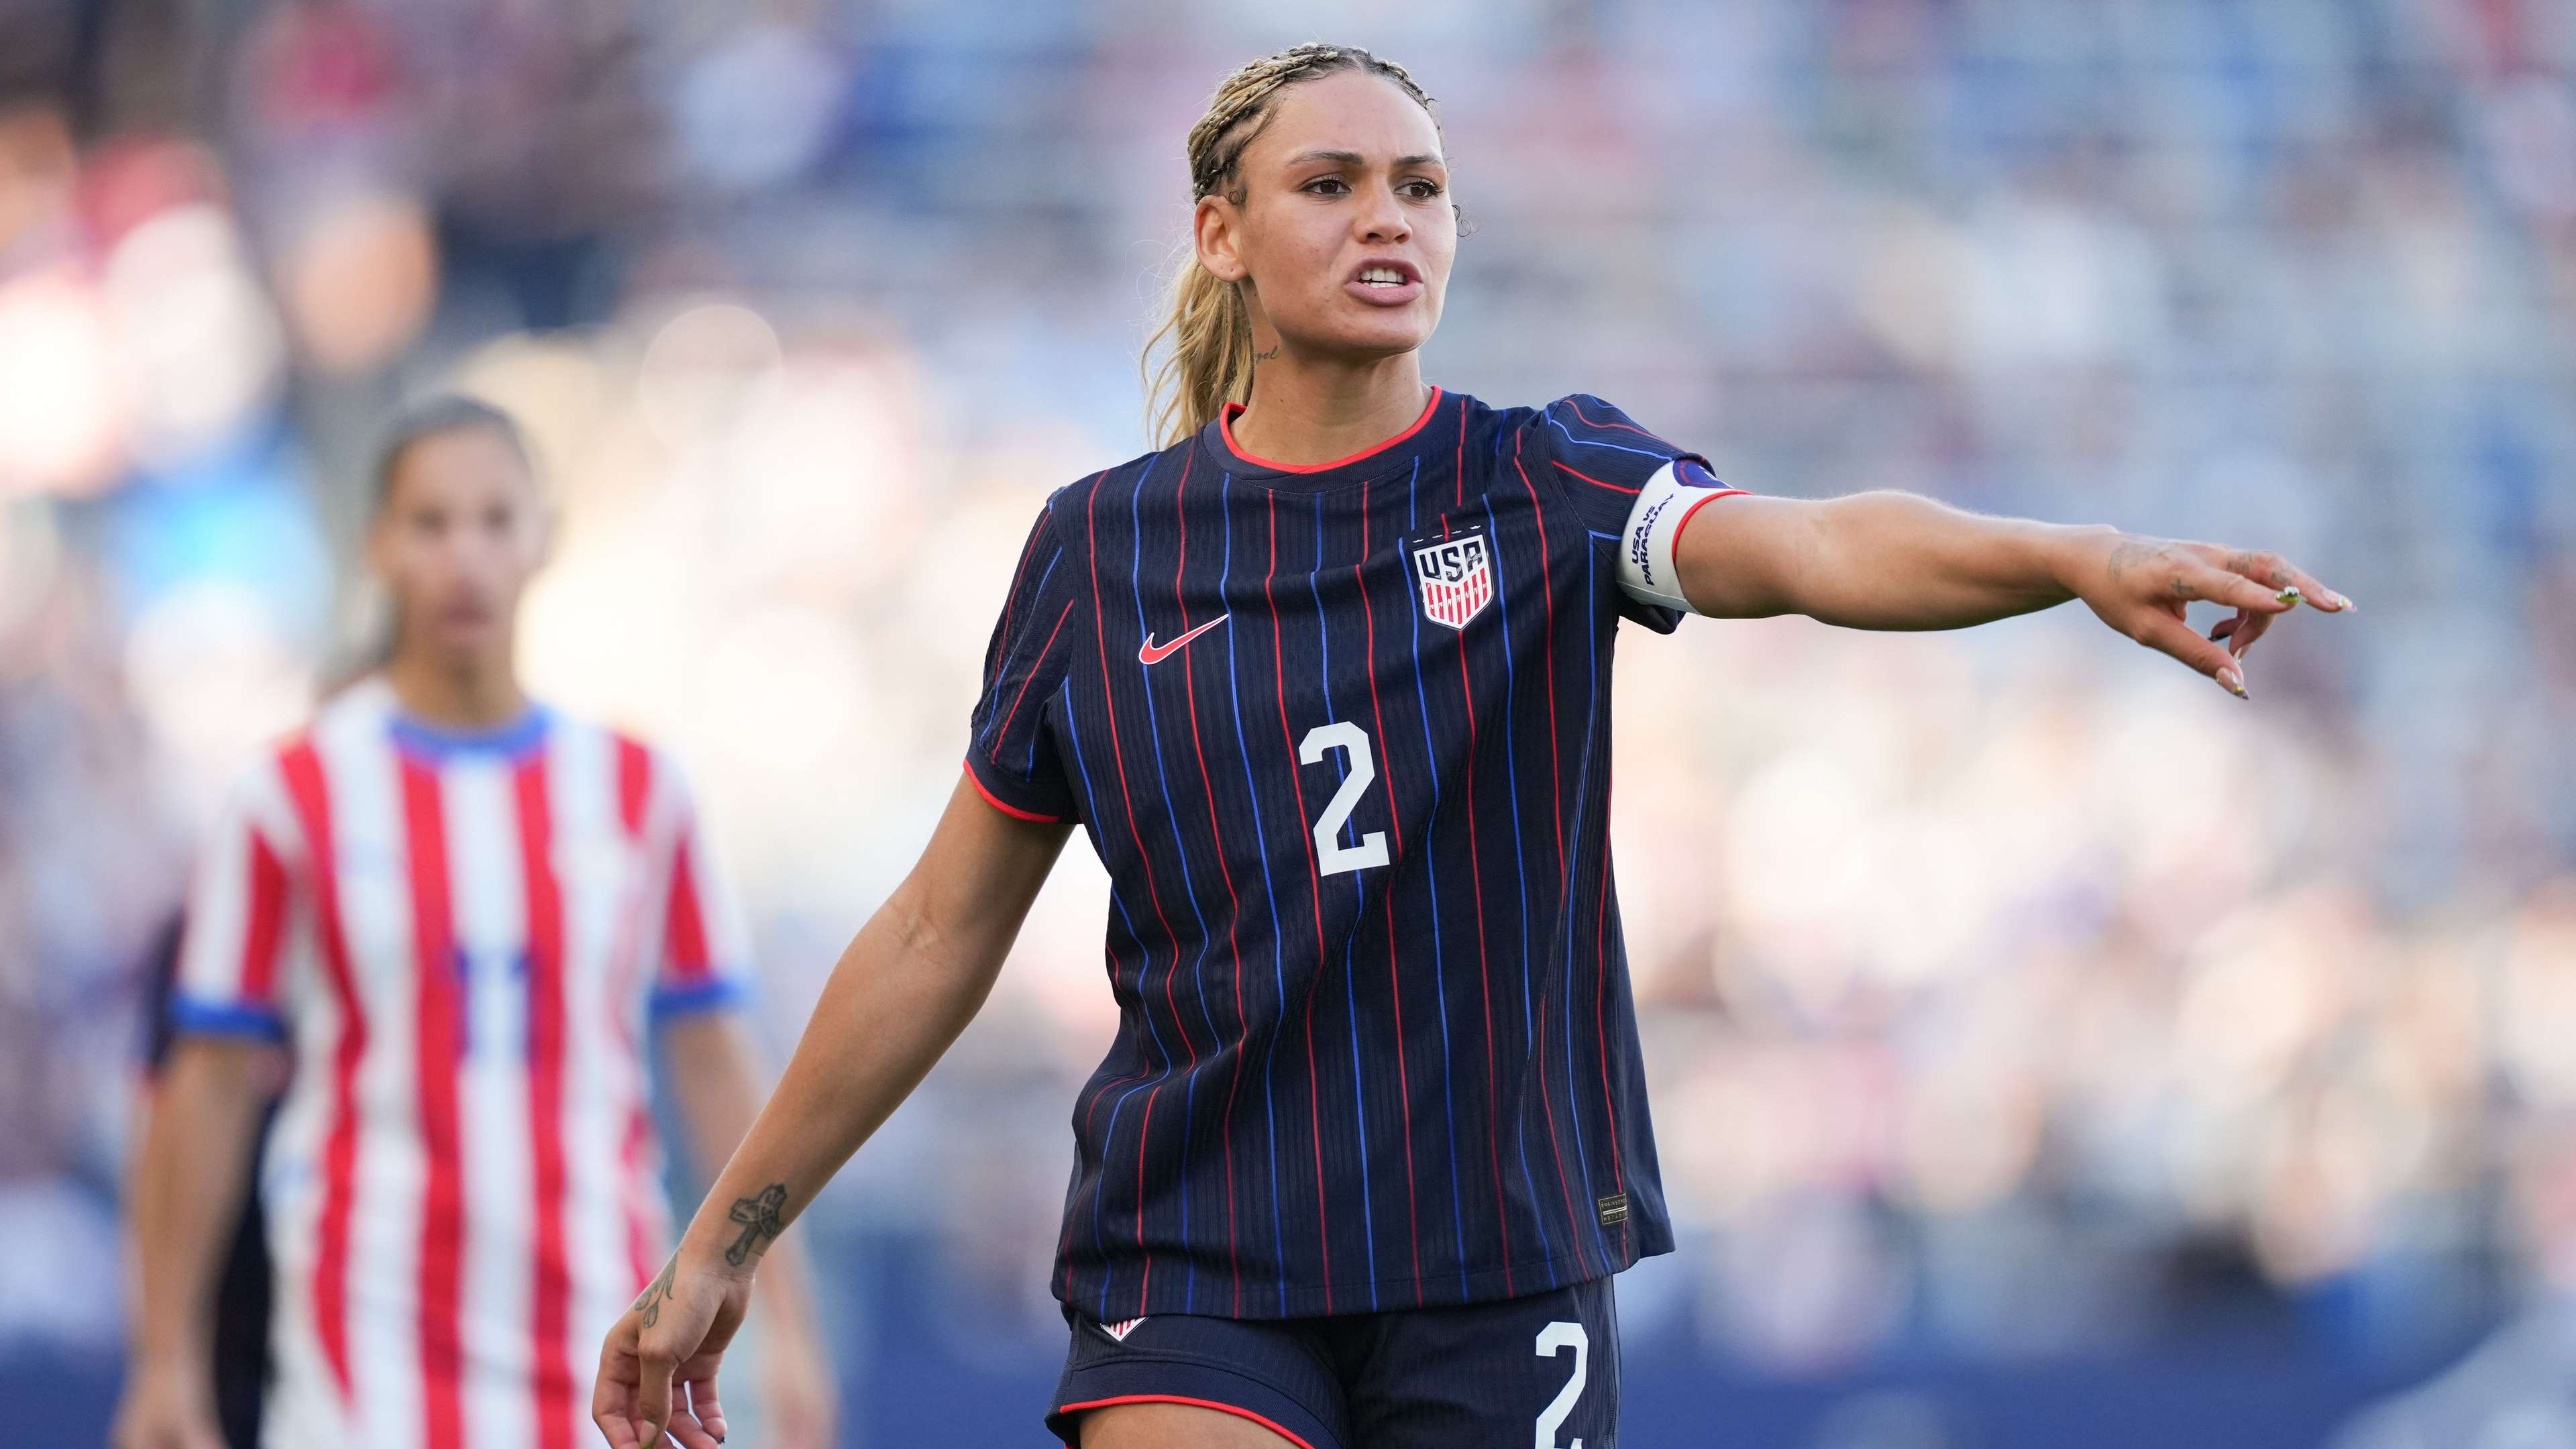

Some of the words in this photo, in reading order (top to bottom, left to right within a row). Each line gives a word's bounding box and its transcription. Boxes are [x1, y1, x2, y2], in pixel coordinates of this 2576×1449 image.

[1419, 541, 1483, 582] USA
[1632, 526, 1644, 564] USA
[1640, 493, 1674, 586] PARAGUAY
[1299, 721, 1390, 877] 2
[1535, 1321, 1588, 1449] 2
